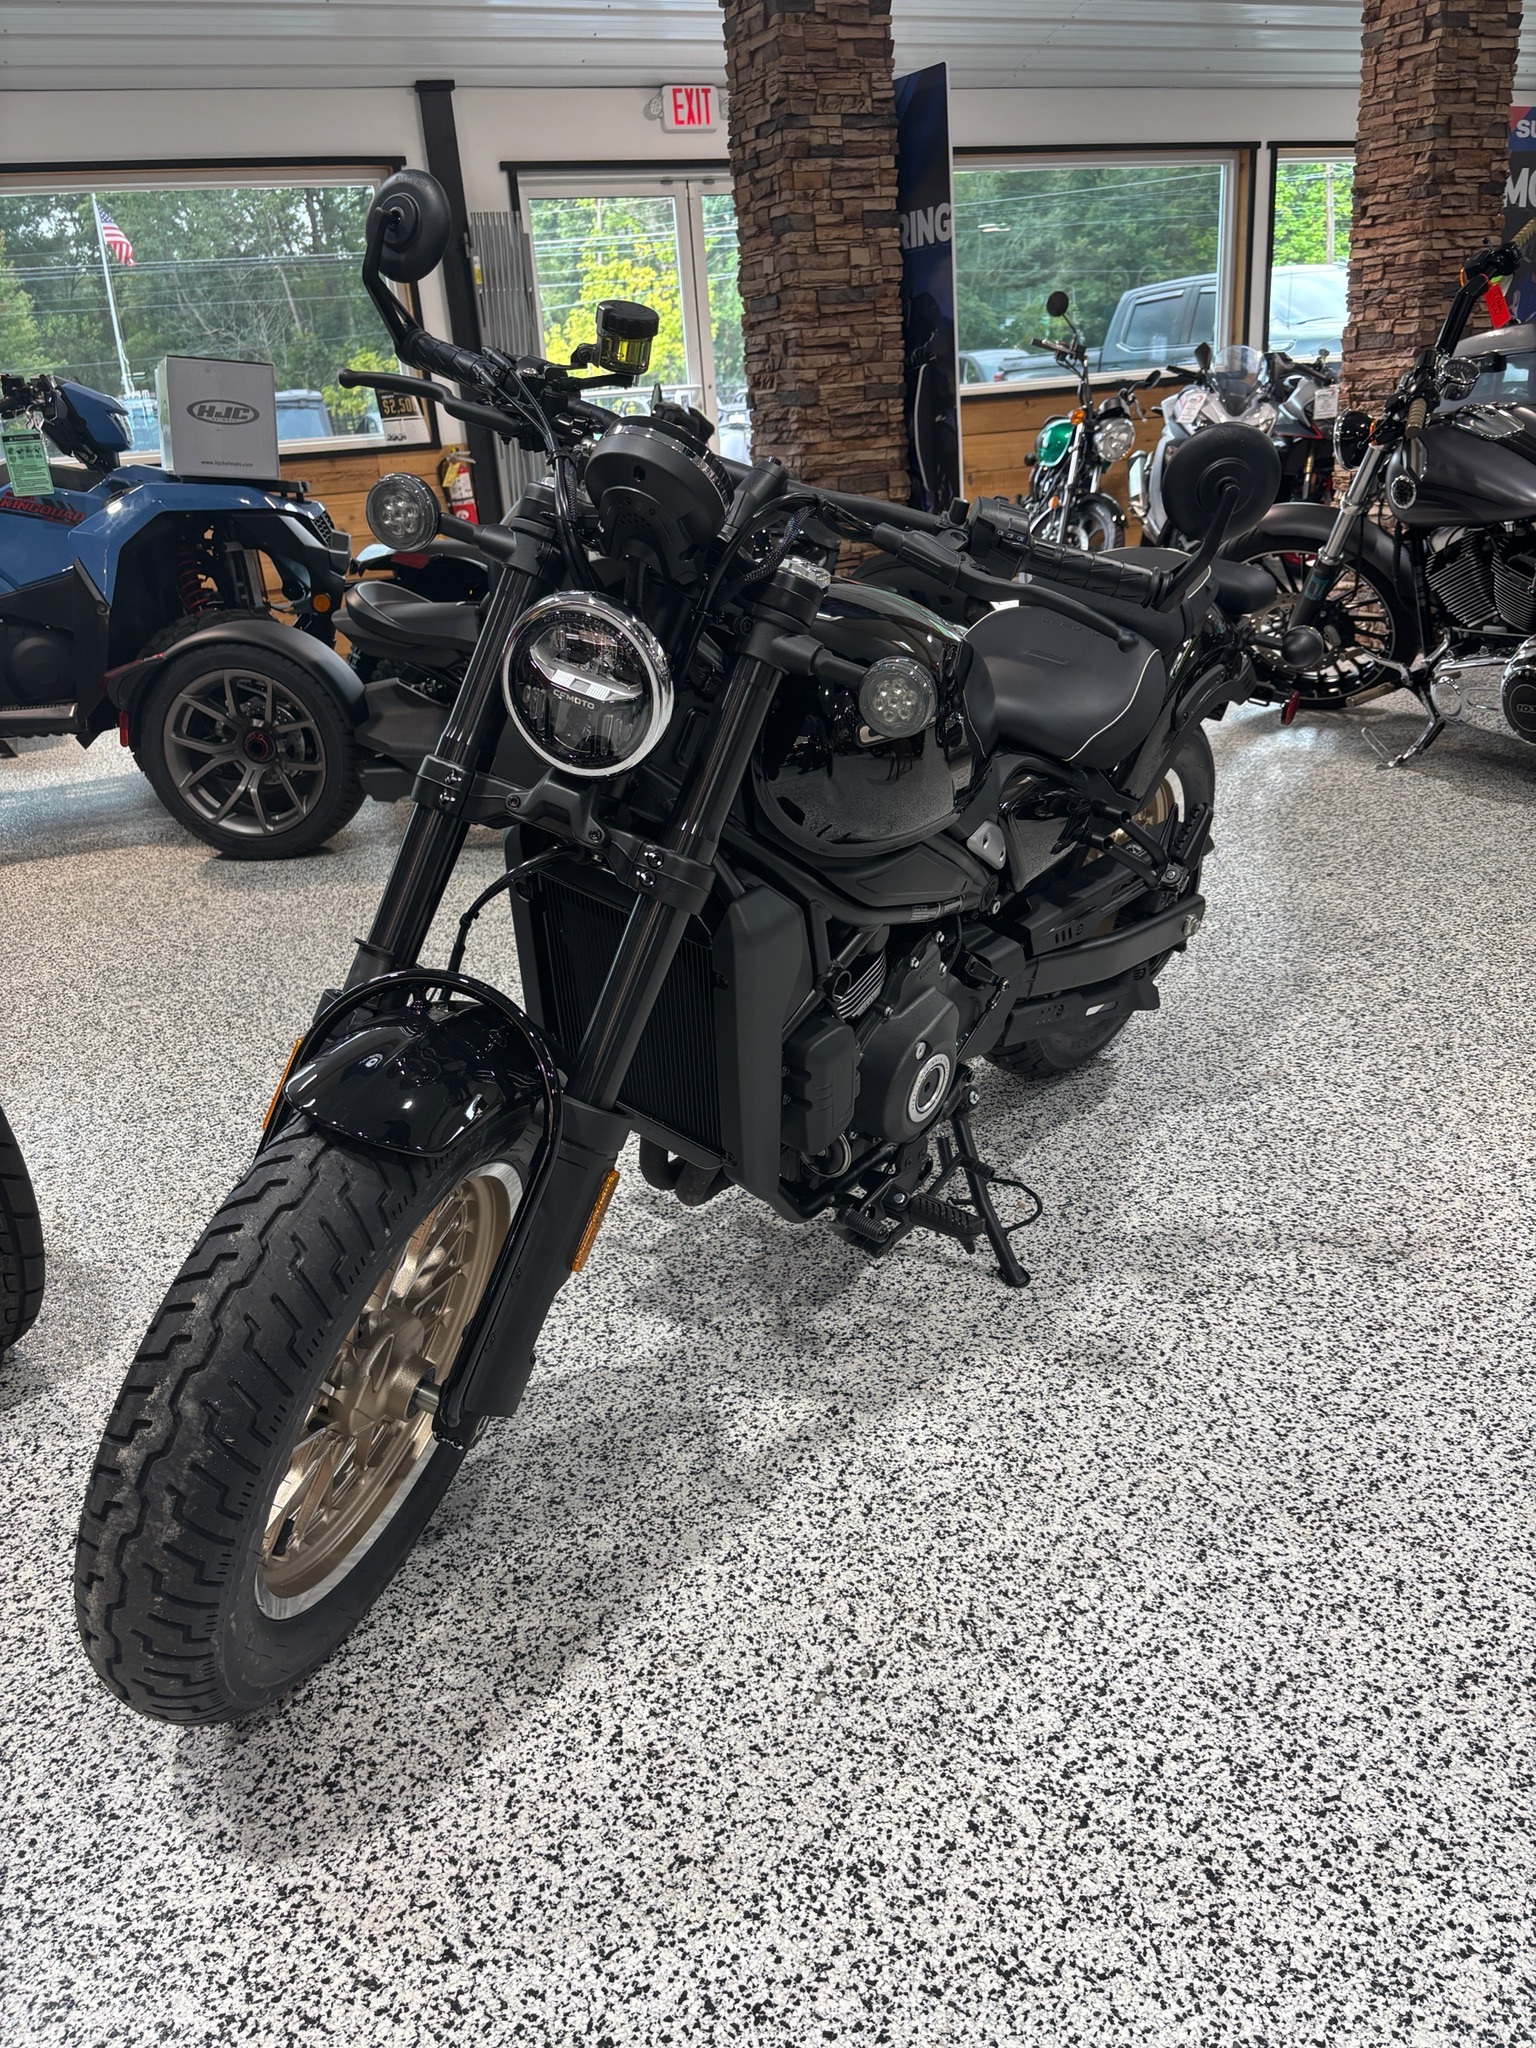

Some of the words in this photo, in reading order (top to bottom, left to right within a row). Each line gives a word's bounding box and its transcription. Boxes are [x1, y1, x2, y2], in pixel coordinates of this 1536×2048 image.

[672, 87, 711, 125] EXIT
[197, 405, 250, 420] HJC
[0, 497, 87, 522] KINGQUAD
[553, 689, 595, 710] CFMOTO
